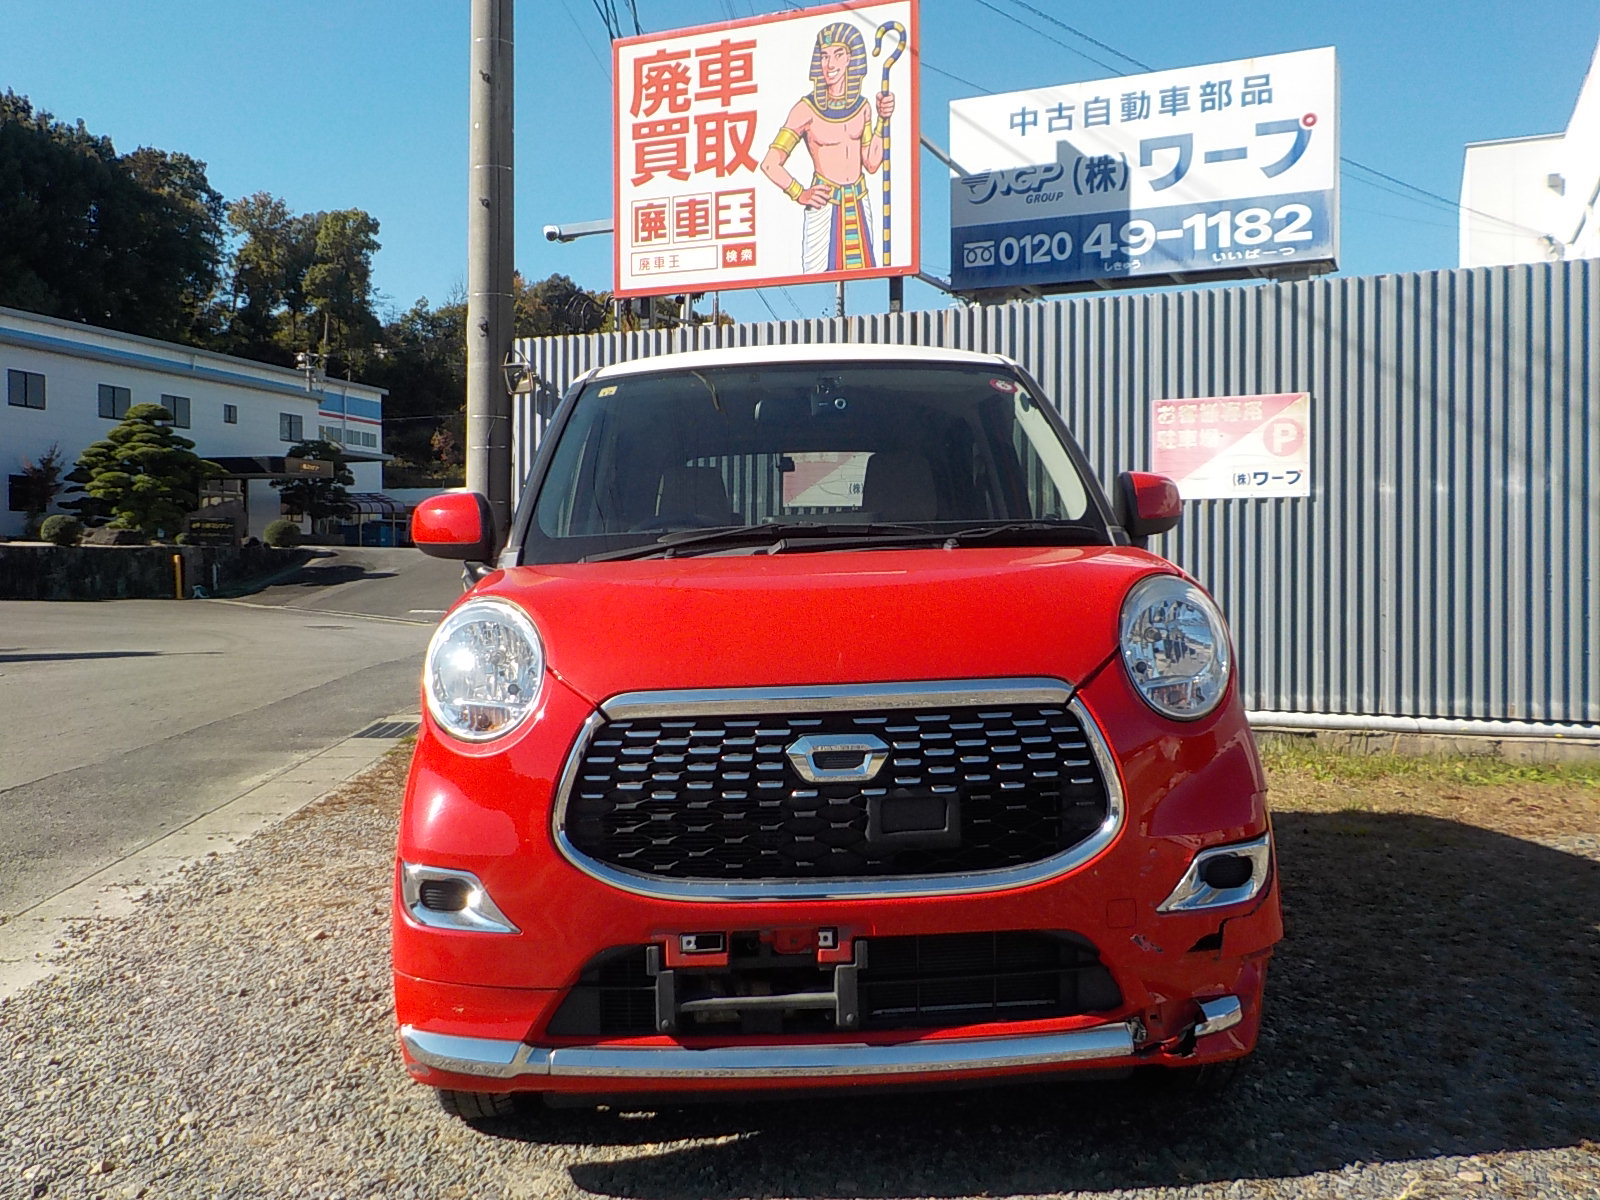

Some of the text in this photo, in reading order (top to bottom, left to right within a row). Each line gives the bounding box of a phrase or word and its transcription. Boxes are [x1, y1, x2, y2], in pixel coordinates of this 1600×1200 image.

[629, 39, 758, 118] 廃車
[1009, 73, 1273, 137] 中古自動車部品
[630, 110, 759, 187] 買取
[633, 188, 756, 243] 廃車王
[1025, 192, 1064, 204] GROUP
[639, 248, 753, 271] 廃車王 検索
[1000, 204, 1313, 266] 0120 49-1182
[1273, 423, 1298, 453] P
